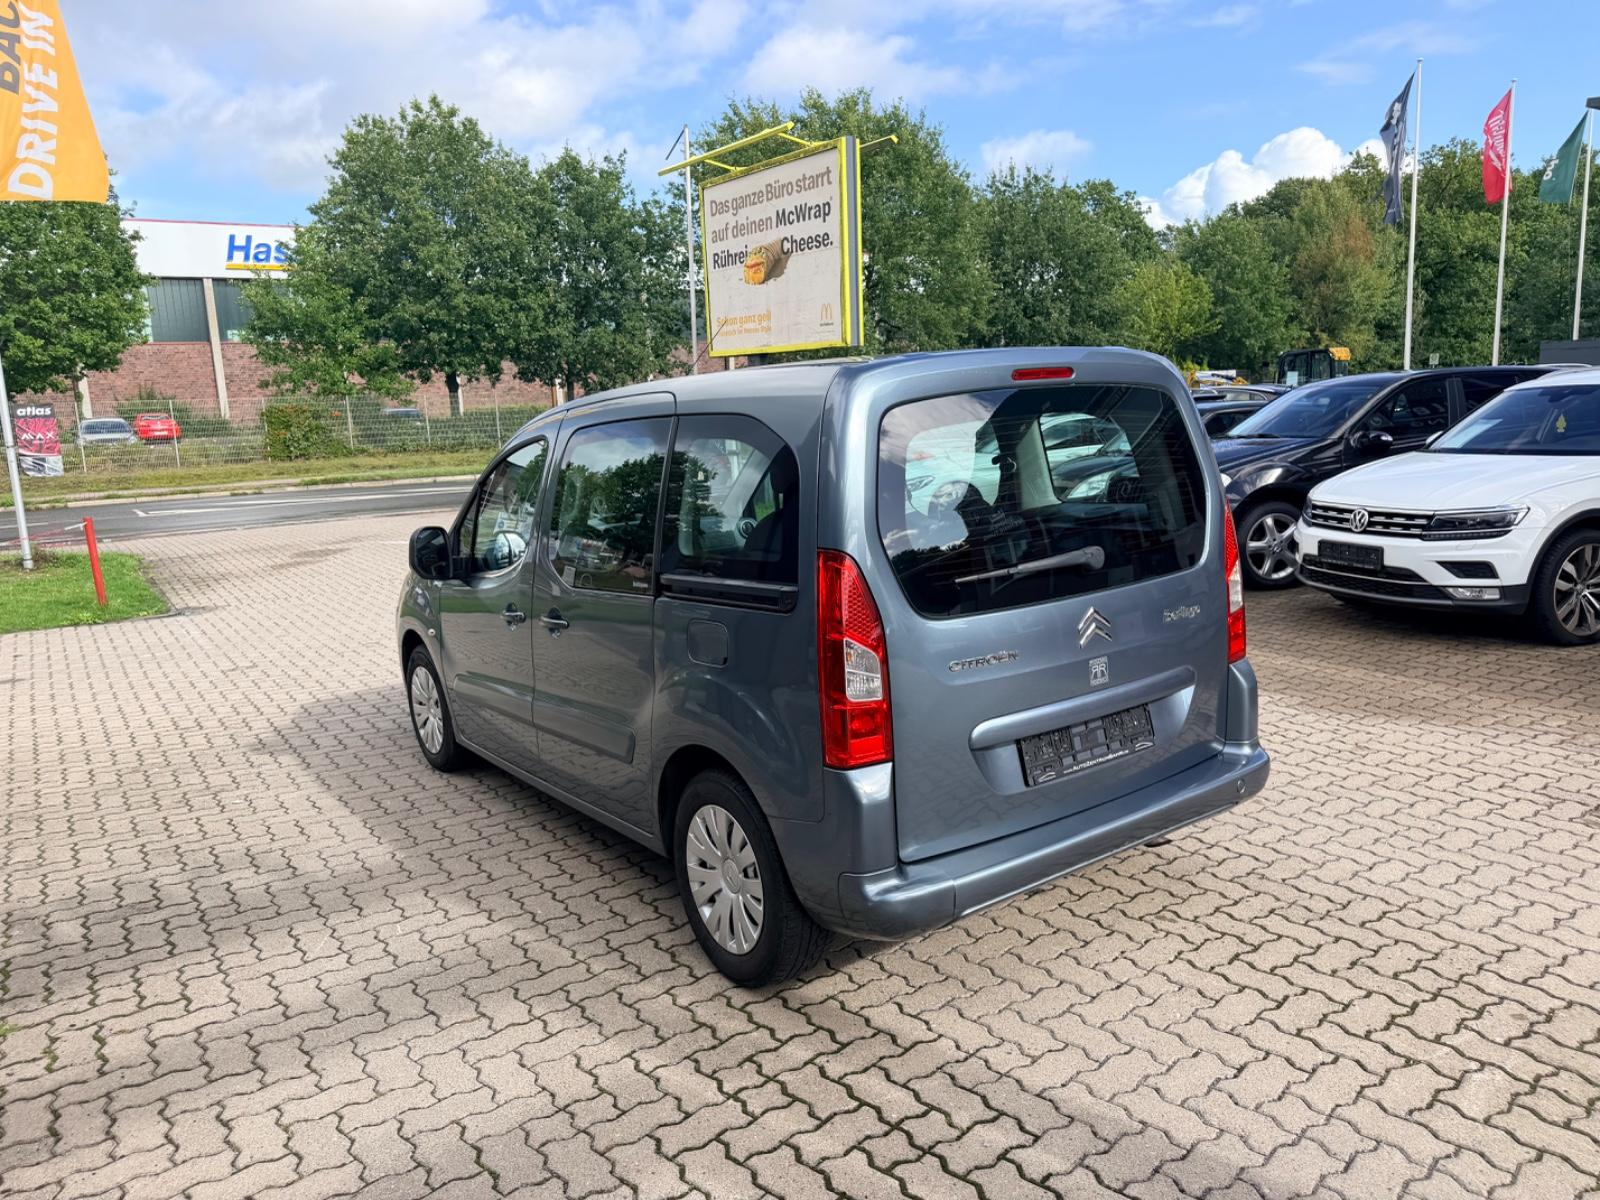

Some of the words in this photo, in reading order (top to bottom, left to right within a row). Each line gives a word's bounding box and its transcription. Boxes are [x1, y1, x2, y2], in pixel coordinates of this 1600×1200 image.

[18, 0, 56, 56] IN
[7, 62, 59, 199] DRIVE
[710, 198, 730, 217] Das
[731, 190, 764, 216] ganze
[765, 179, 794, 202] Büro
[795, 166, 832, 194] starrt
[711, 222, 730, 244] auf
[731, 216, 773, 239] deinen
[713, 245, 748, 270] Rührei
[780, 231, 834, 255] Cheese.
[16, 406, 52, 416] atlas
